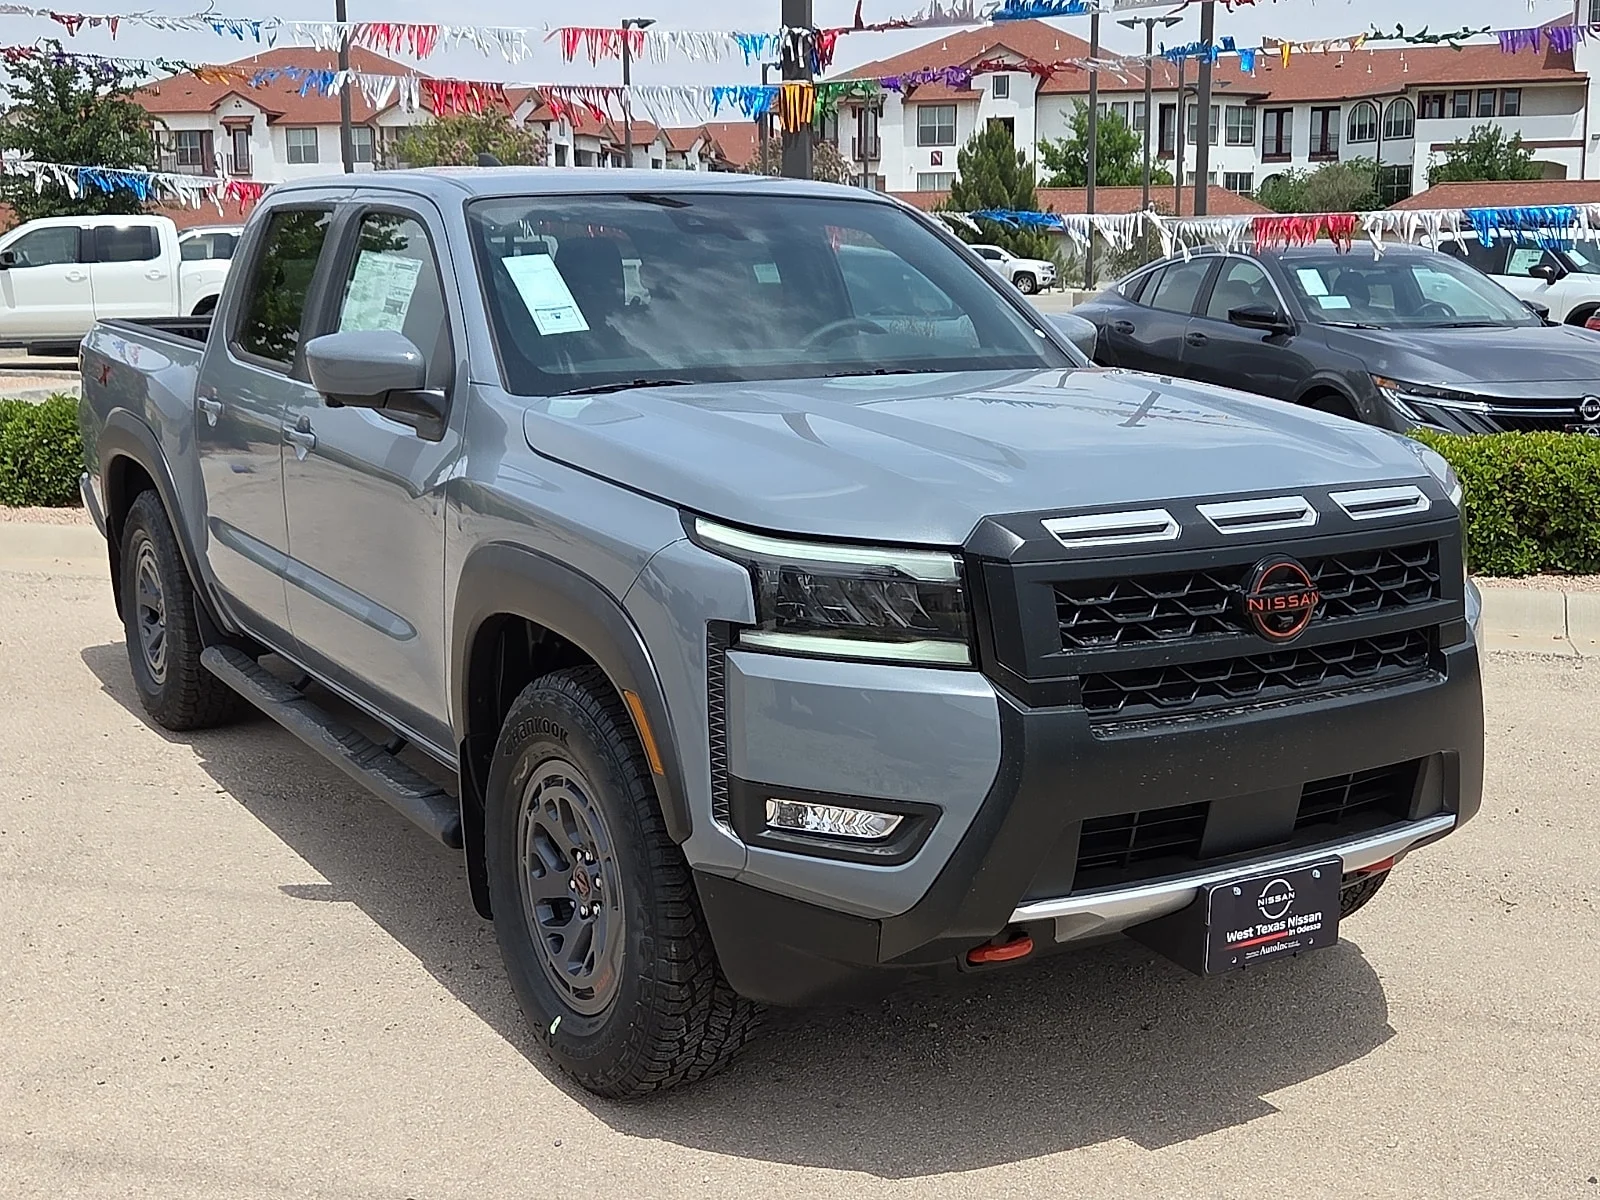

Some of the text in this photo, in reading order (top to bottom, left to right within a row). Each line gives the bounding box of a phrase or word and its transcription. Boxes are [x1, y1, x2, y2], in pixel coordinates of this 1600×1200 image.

[932, 152, 942, 164] N
[1248, 591, 1319, 611] NISSAN
[1257, 892, 1296, 907] NISSAN
[1226, 912, 1322, 943] West Texas Nissan
[1296, 922, 1322, 935] Odessa
